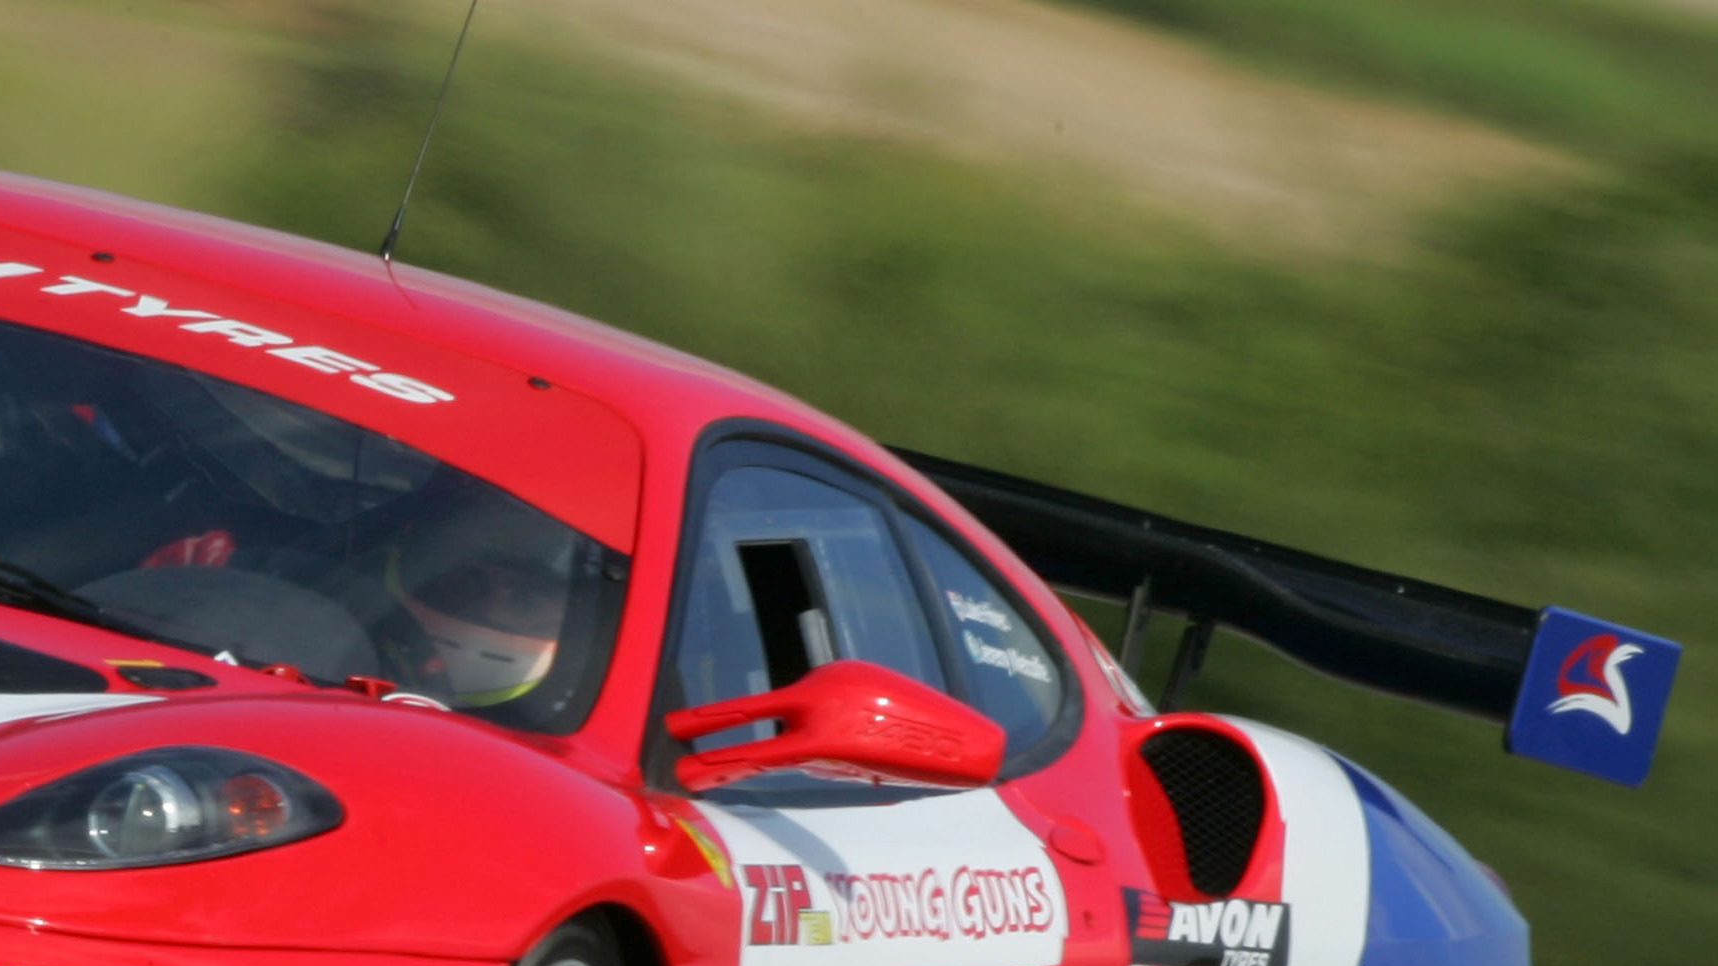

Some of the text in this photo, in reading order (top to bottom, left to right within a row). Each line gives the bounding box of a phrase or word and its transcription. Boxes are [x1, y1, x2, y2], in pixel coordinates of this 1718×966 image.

[40, 274, 456, 405] TYRES
[823, 866, 951, 942] YOUNG
[949, 864, 1055, 941] GUNS
[1168, 897, 1283, 951] AVON
